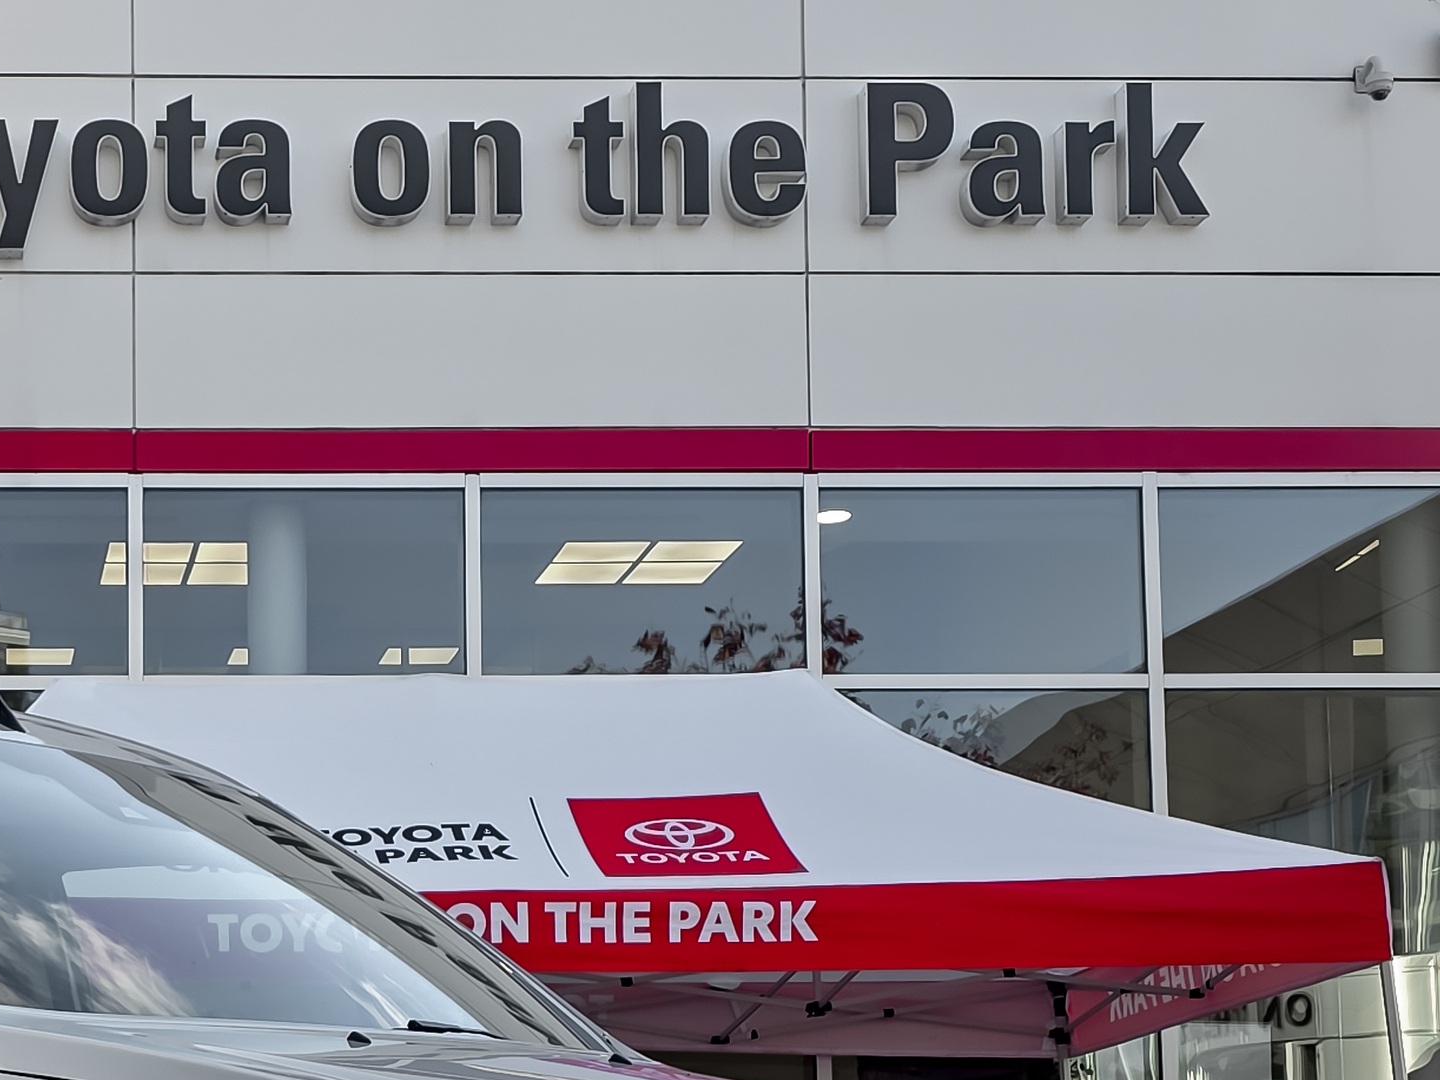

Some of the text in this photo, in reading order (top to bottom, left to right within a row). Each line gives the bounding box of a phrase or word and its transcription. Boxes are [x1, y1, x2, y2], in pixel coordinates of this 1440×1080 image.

[352, 119, 523, 224] on
[570, 82, 807, 226] the
[860, 82, 1210, 226] Park
[374, 845, 518, 864] PARK
[616, 850, 770, 864] TOYOTA
[447, 901, 529, 944] ON
[544, 901, 652, 944] THE
[669, 901, 819, 943] PARK
